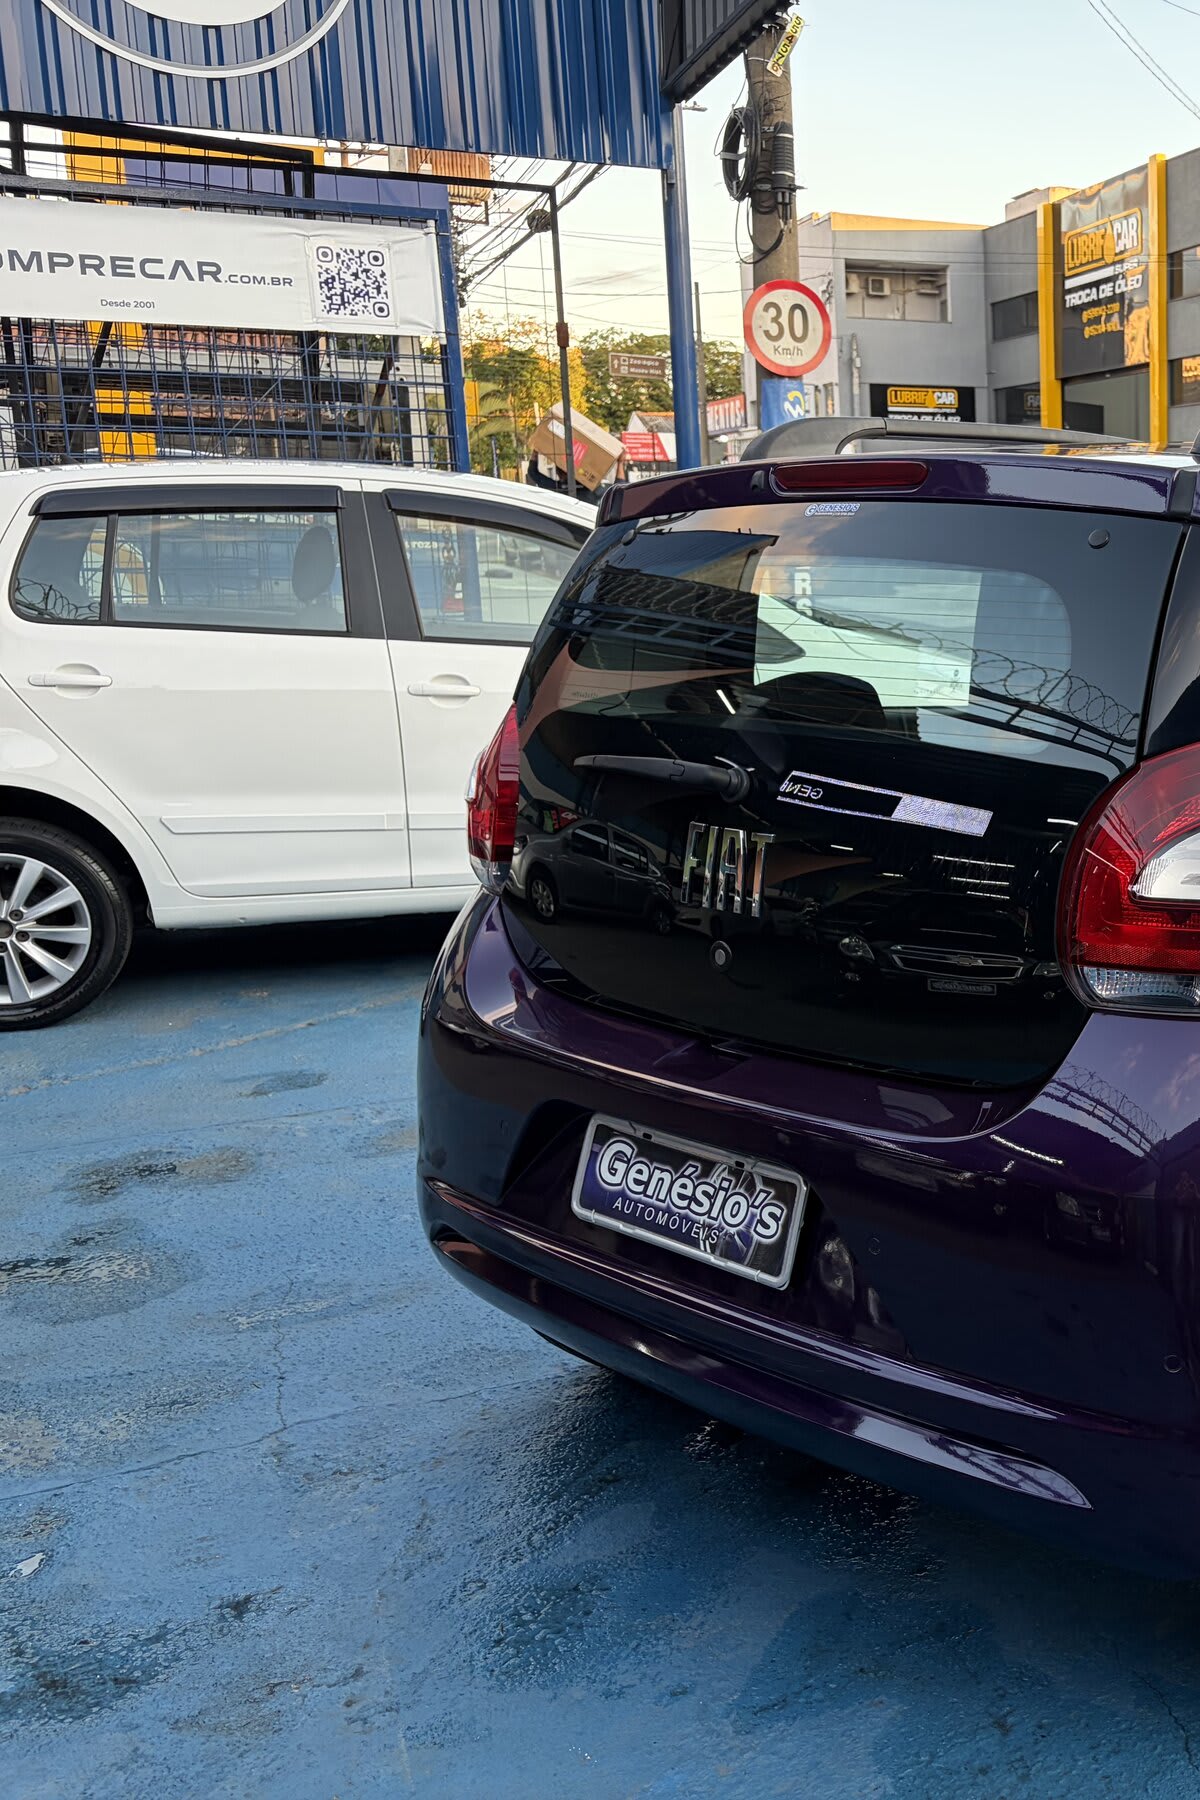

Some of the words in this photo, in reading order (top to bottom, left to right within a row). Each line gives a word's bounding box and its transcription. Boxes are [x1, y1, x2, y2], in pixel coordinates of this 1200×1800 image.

[0, 248, 294, 288] MPRECAR.COM.BR
[100, 299, 131, 308] Desde
[133, 300, 156, 309] 2001
[1065, 288, 1098, 308] TROCA
[1098, 282, 1114, 299] DE
[1115, 275, 1143, 292] ÓLEO
[762, 301, 810, 344] 30
[773, 344, 803, 357] Km/h
[680, 820, 777, 918] FIAT
[598, 1138, 784, 1240] Genésio's
[612, 1196, 719, 1245] AUTOMÓVEIS
